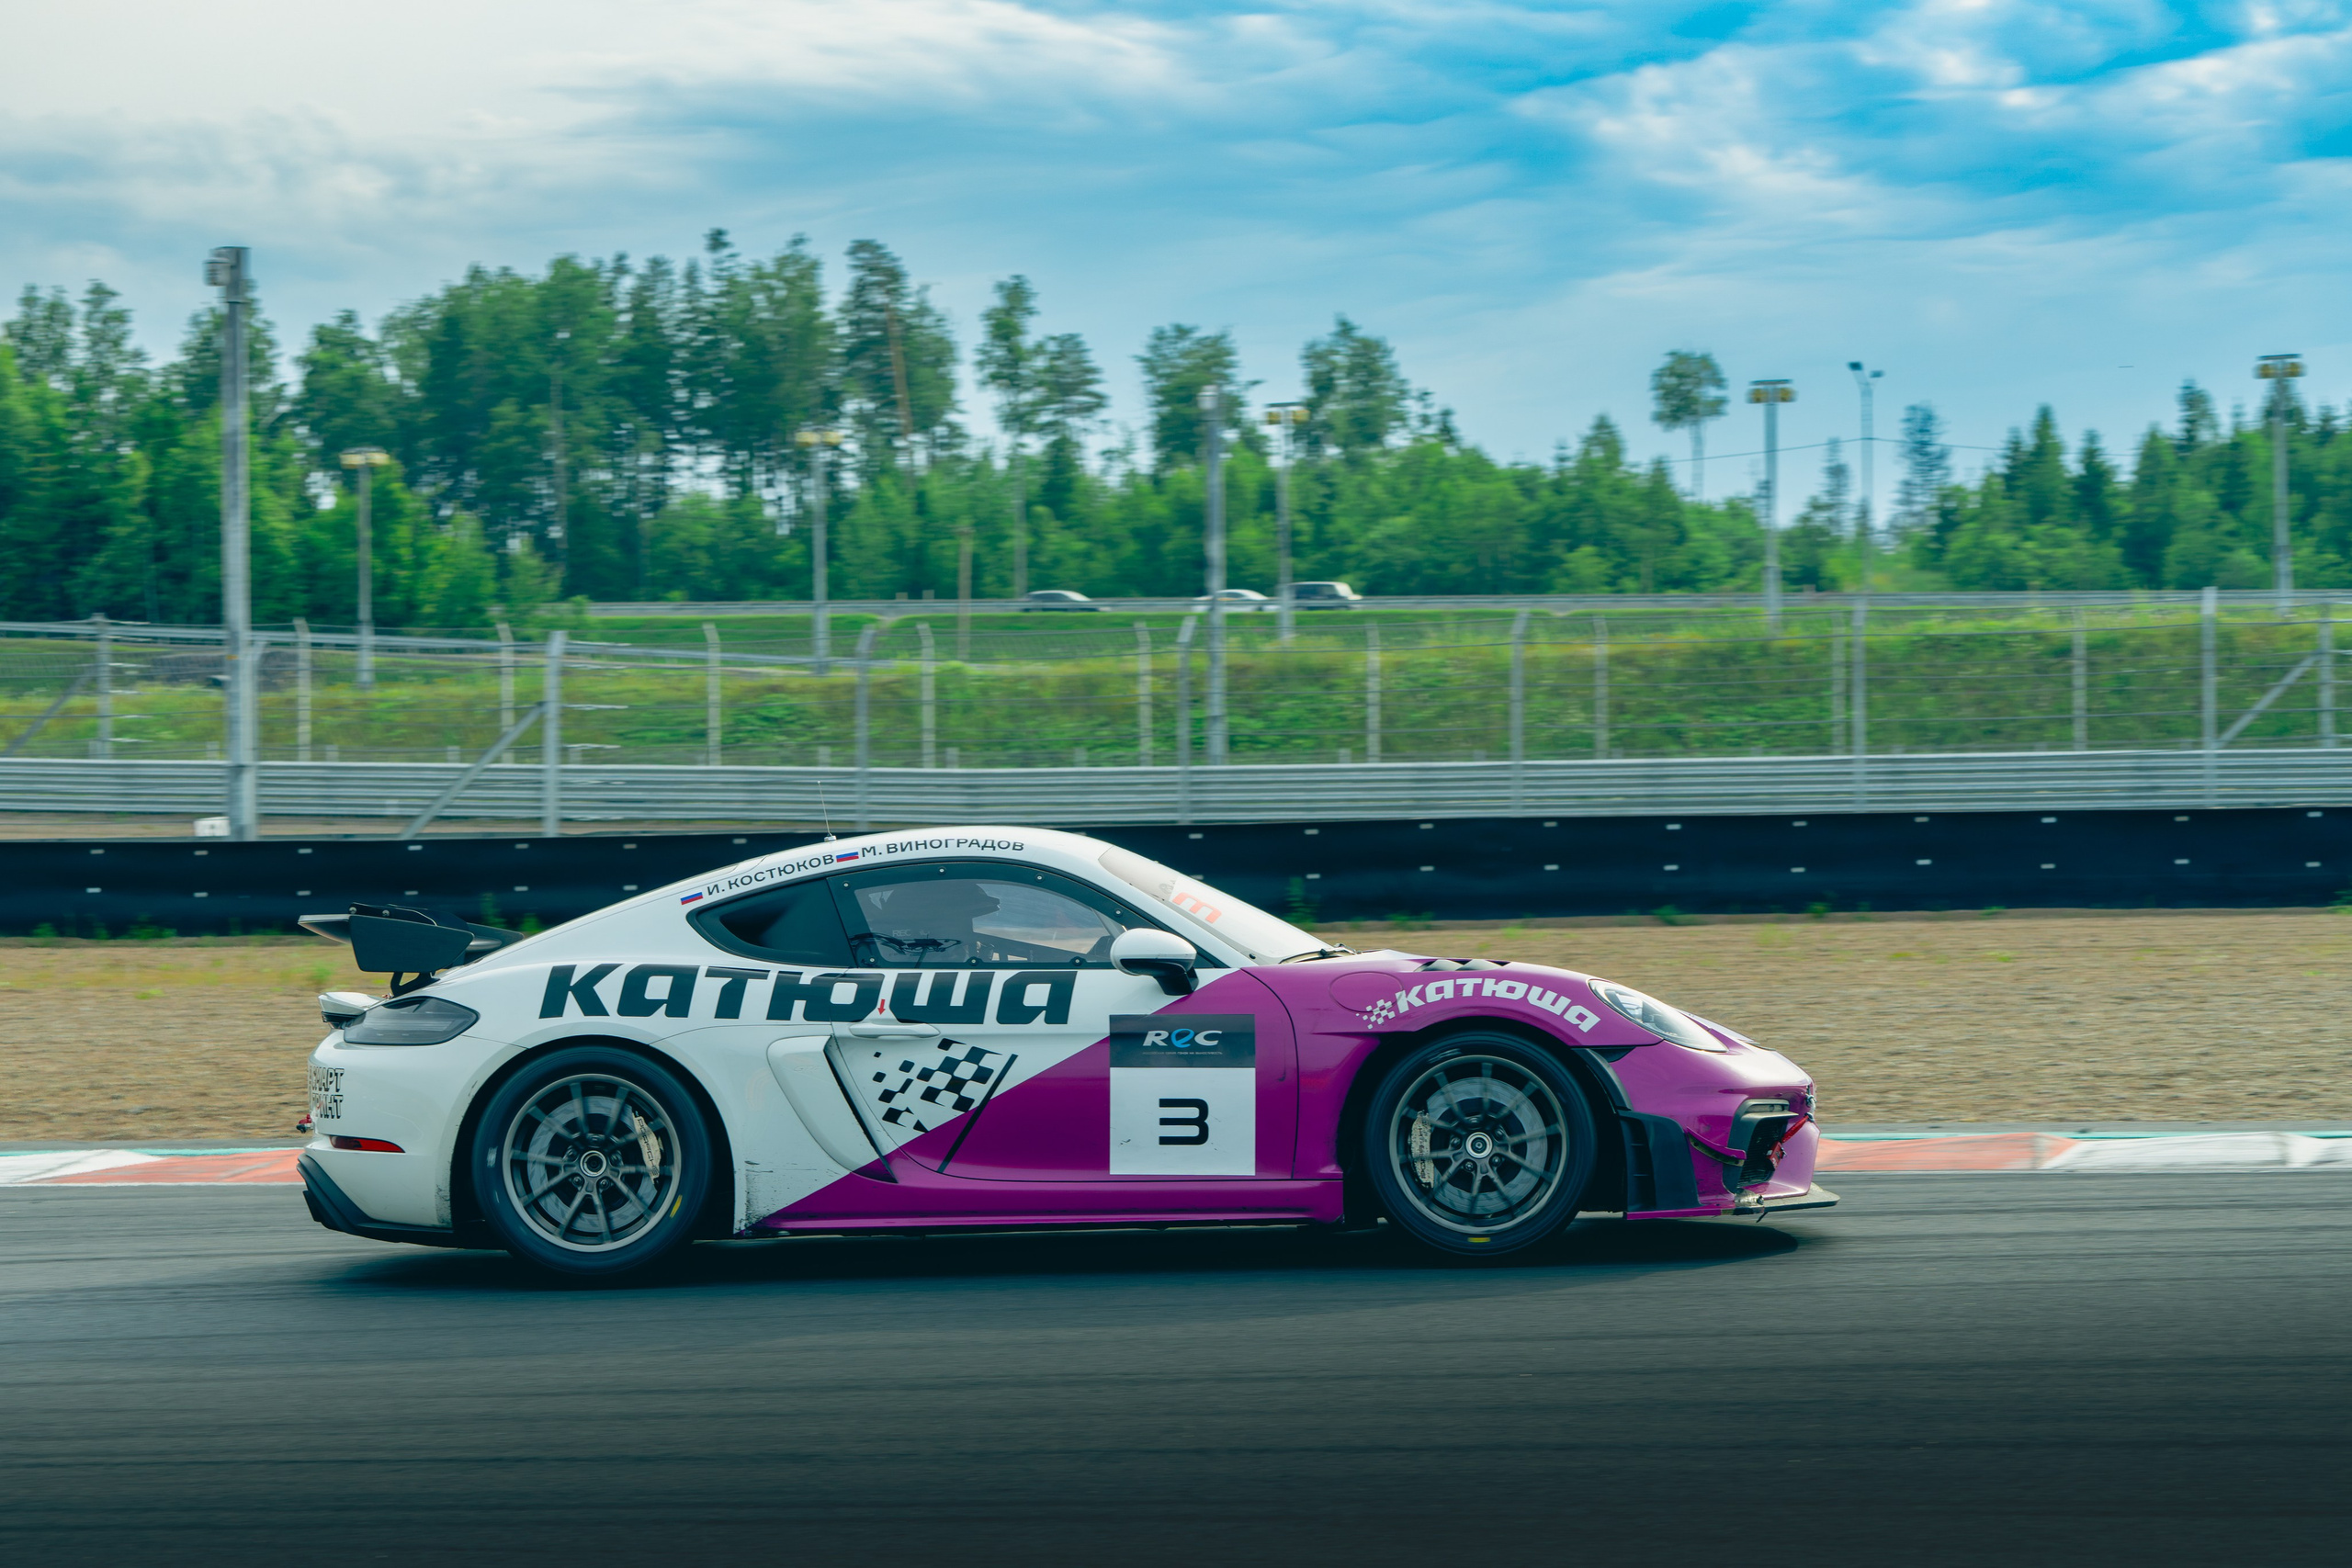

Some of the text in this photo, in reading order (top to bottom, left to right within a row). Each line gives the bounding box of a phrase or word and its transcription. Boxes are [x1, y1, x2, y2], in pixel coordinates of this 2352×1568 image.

[862, 837, 1024, 858] М. ВИНОГРАДОВ
[707, 853, 835, 897] И. КОСТЮКОВ
[1159, 1098, 1209, 1145] 3
